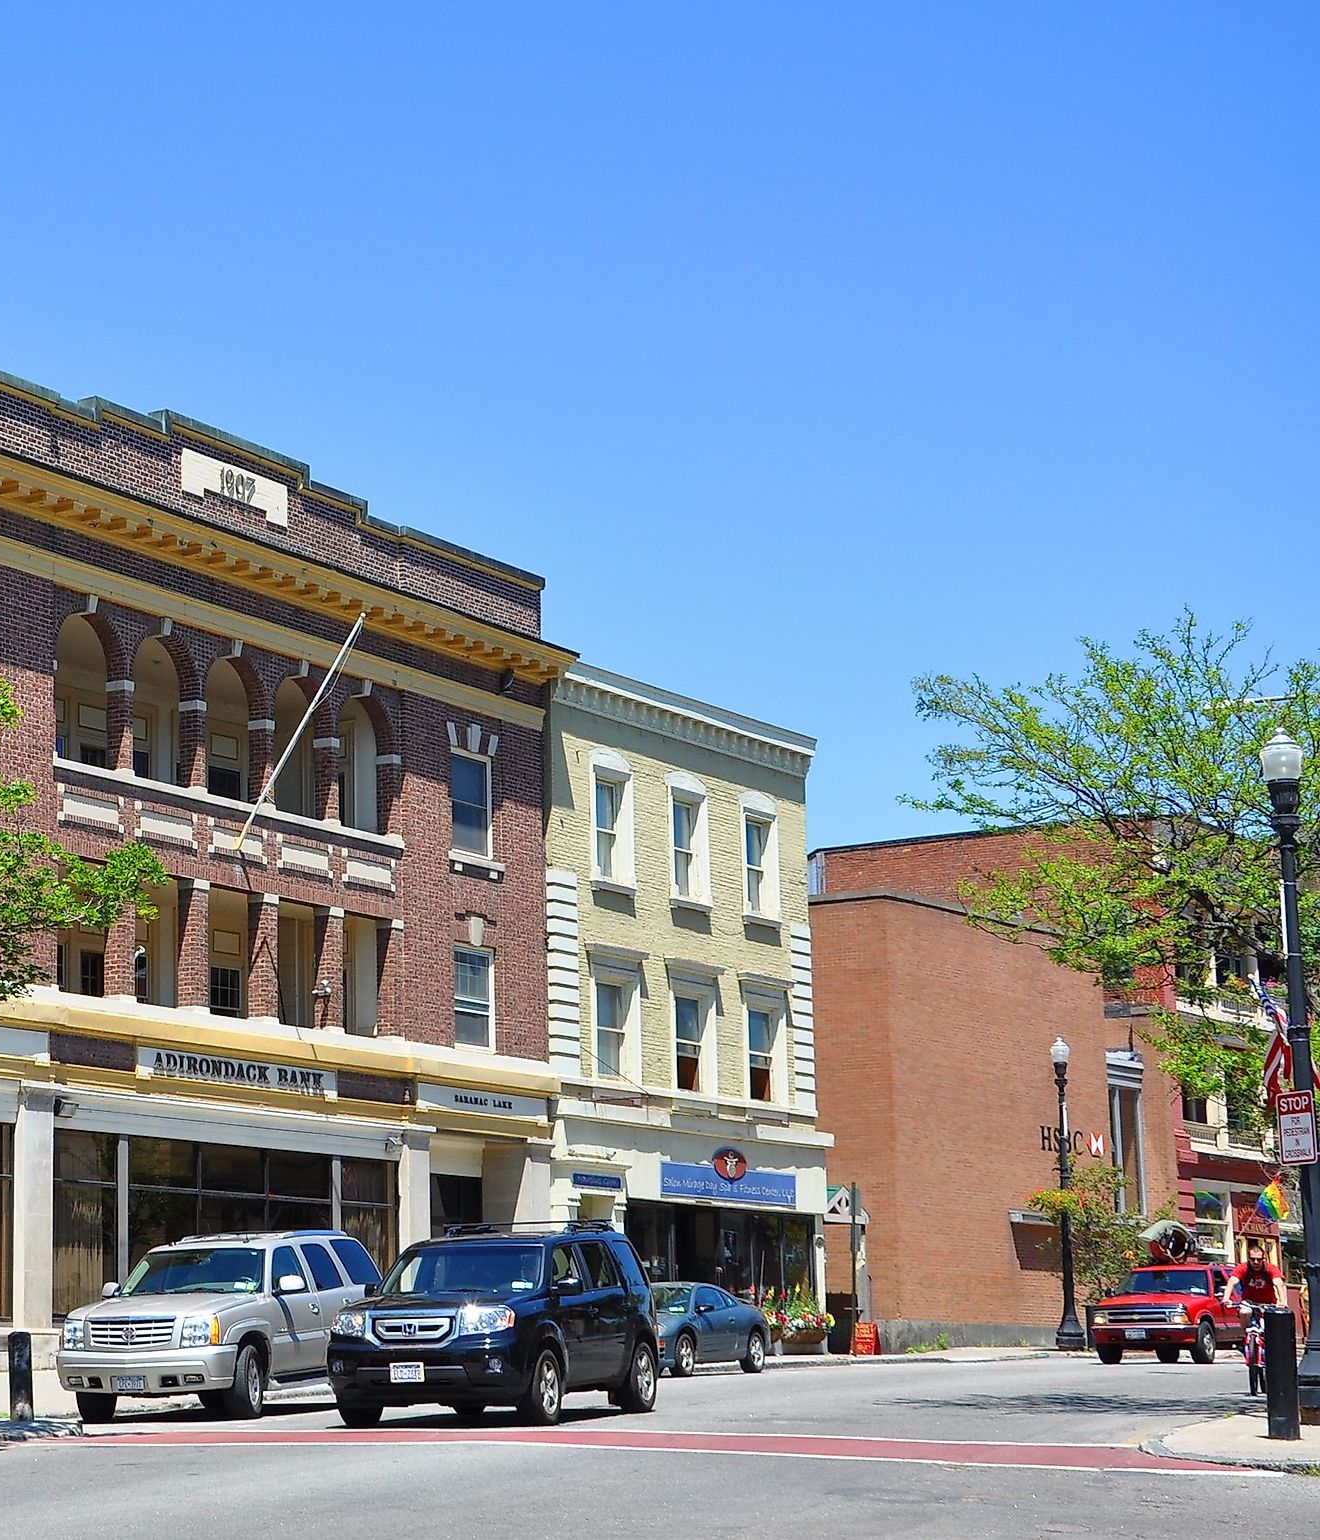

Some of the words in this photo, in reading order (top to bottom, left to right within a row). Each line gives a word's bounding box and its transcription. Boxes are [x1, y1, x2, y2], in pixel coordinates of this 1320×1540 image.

[219, 466, 256, 501] 1907
[154, 1052, 270, 1083] ADIRONDACK
[277, 1068, 324, 1089] BANK
[454, 1095, 488, 1106] SARANAC
[493, 1099, 513, 1110] LAKE
[1280, 1096, 1309, 1112] STOP
